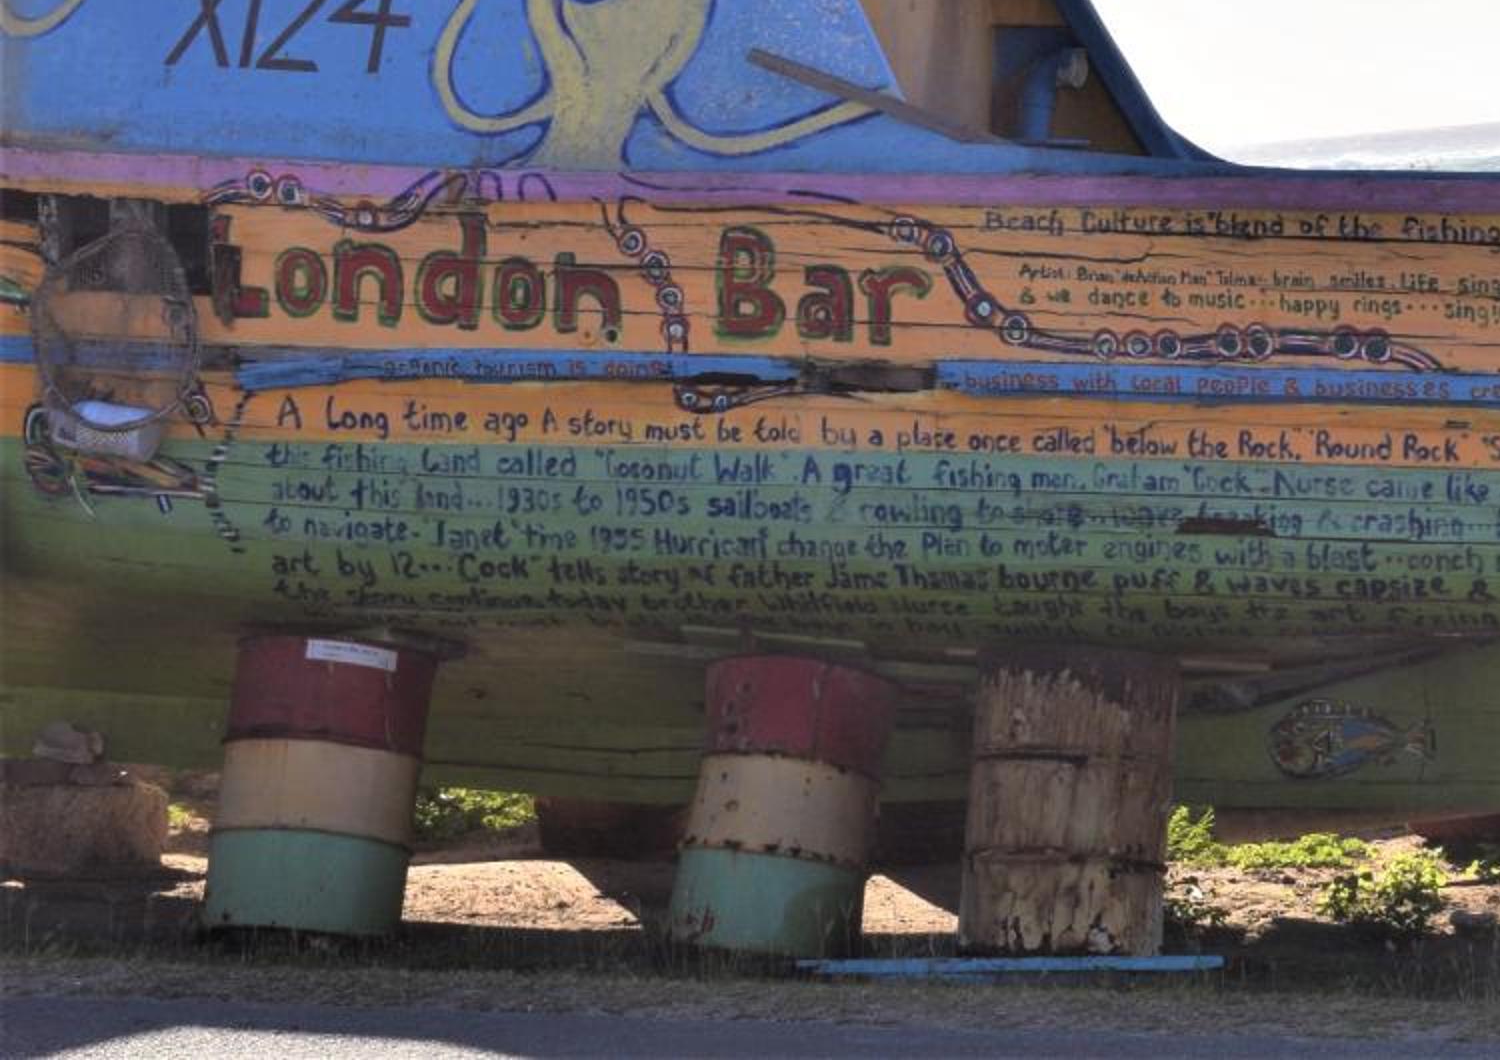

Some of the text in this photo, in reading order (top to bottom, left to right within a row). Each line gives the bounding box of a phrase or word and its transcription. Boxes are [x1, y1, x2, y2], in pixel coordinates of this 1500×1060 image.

[983, 211, 1062, 236] Beach
[1081, 212, 1173, 234] Culture
[1299, 216, 1329, 235] of
[1339, 215, 1382, 238] the
[211, 214, 934, 346] London Bar
[1088, 286, 1150, 310] dance
[1160, 288, 1181, 307] to
[1280, 294, 1340, 321] happy
[277, 394, 302, 429] A
[403, 396, 467, 431] time
[483, 411, 528, 442] ago
[542, 407, 558, 434] A
[569, 408, 632, 438] story
[645, 414, 705, 443] must
[717, 416, 741, 442] be
[867, 426, 884, 445] a
[897, 421, 955, 449] place
[968, 431, 1026, 458] once
[1032, 426, 1095, 454] called
[1187, 429, 1228, 458] the
[498, 447, 577, 477] called
[801, 454, 821, 483] A
[571, 485, 604, 516] to
[980, 532, 1000, 558] to
[272, 551, 321, 577] art
[336, 549, 377, 587] by
